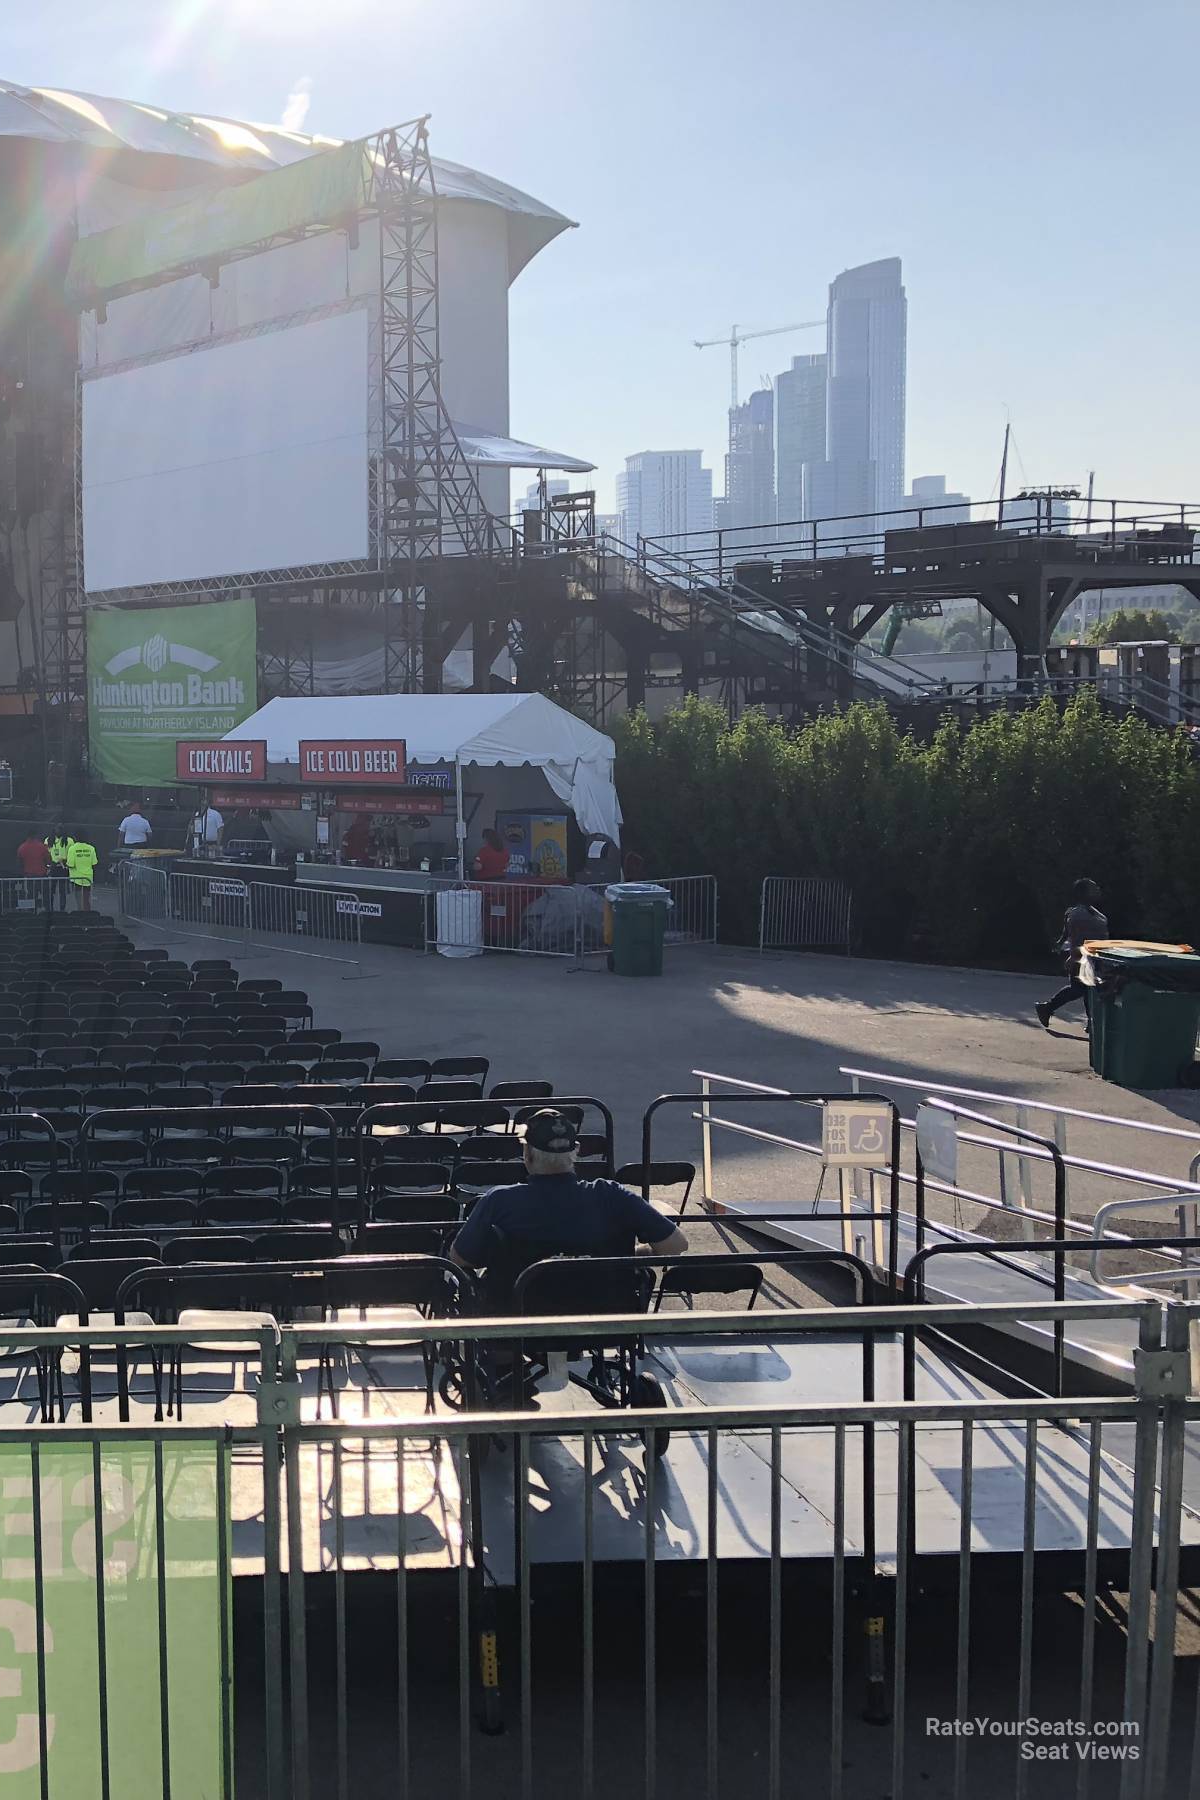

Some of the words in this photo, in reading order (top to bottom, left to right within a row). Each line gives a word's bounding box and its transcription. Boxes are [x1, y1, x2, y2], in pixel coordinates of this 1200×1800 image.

[93, 677, 184, 715] Huntington
[188, 674, 244, 705] Bank
[143, 717, 192, 729] NORTHERLY
[195, 716, 235, 729] ISLAND
[189, 750, 252, 773] COCKTAILS
[306, 750, 324, 773] ICE
[328, 750, 360, 773] COLD
[364, 750, 398, 773] BEER
